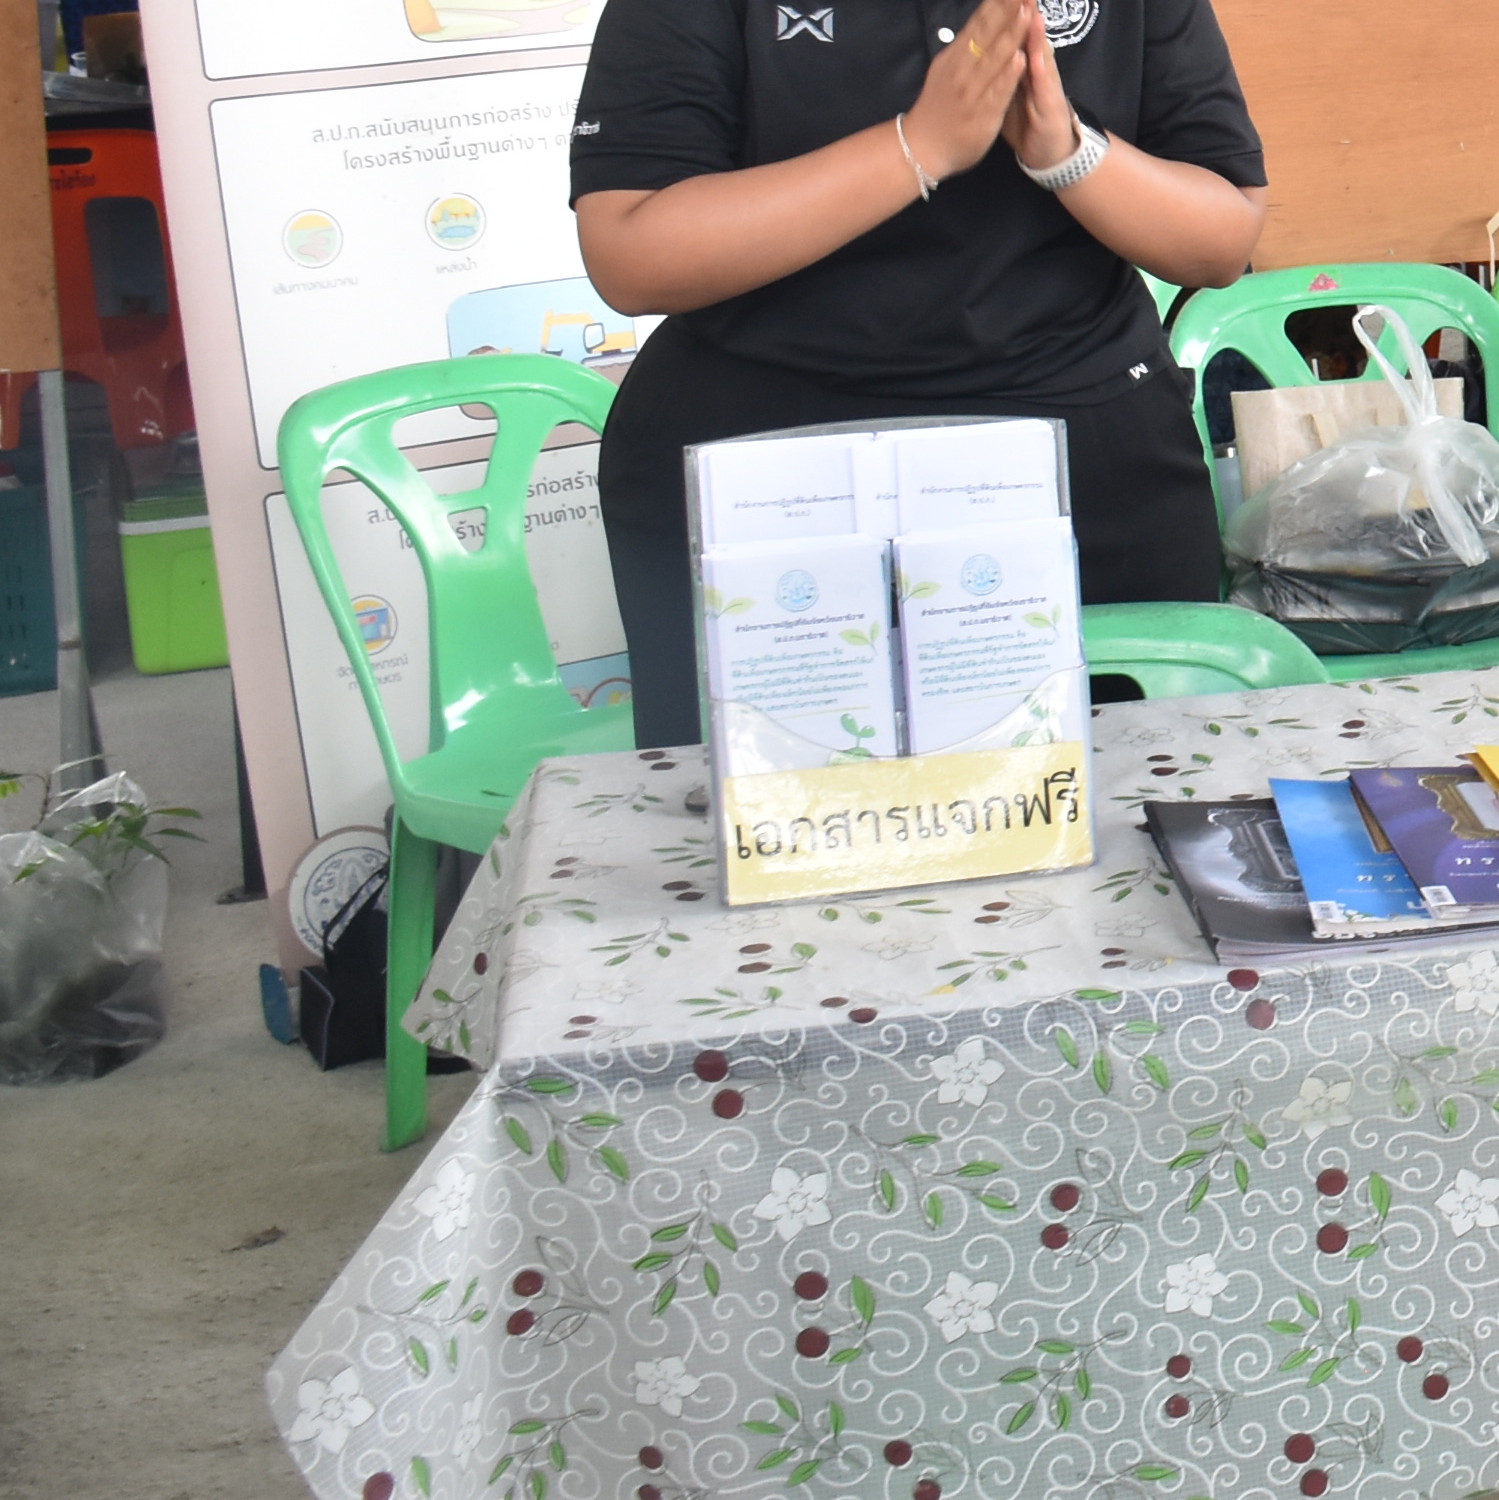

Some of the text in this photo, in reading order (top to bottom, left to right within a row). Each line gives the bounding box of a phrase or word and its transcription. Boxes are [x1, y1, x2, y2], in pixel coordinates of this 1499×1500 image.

[735, 767, 1080, 860] เอกสารแจกฟรี
